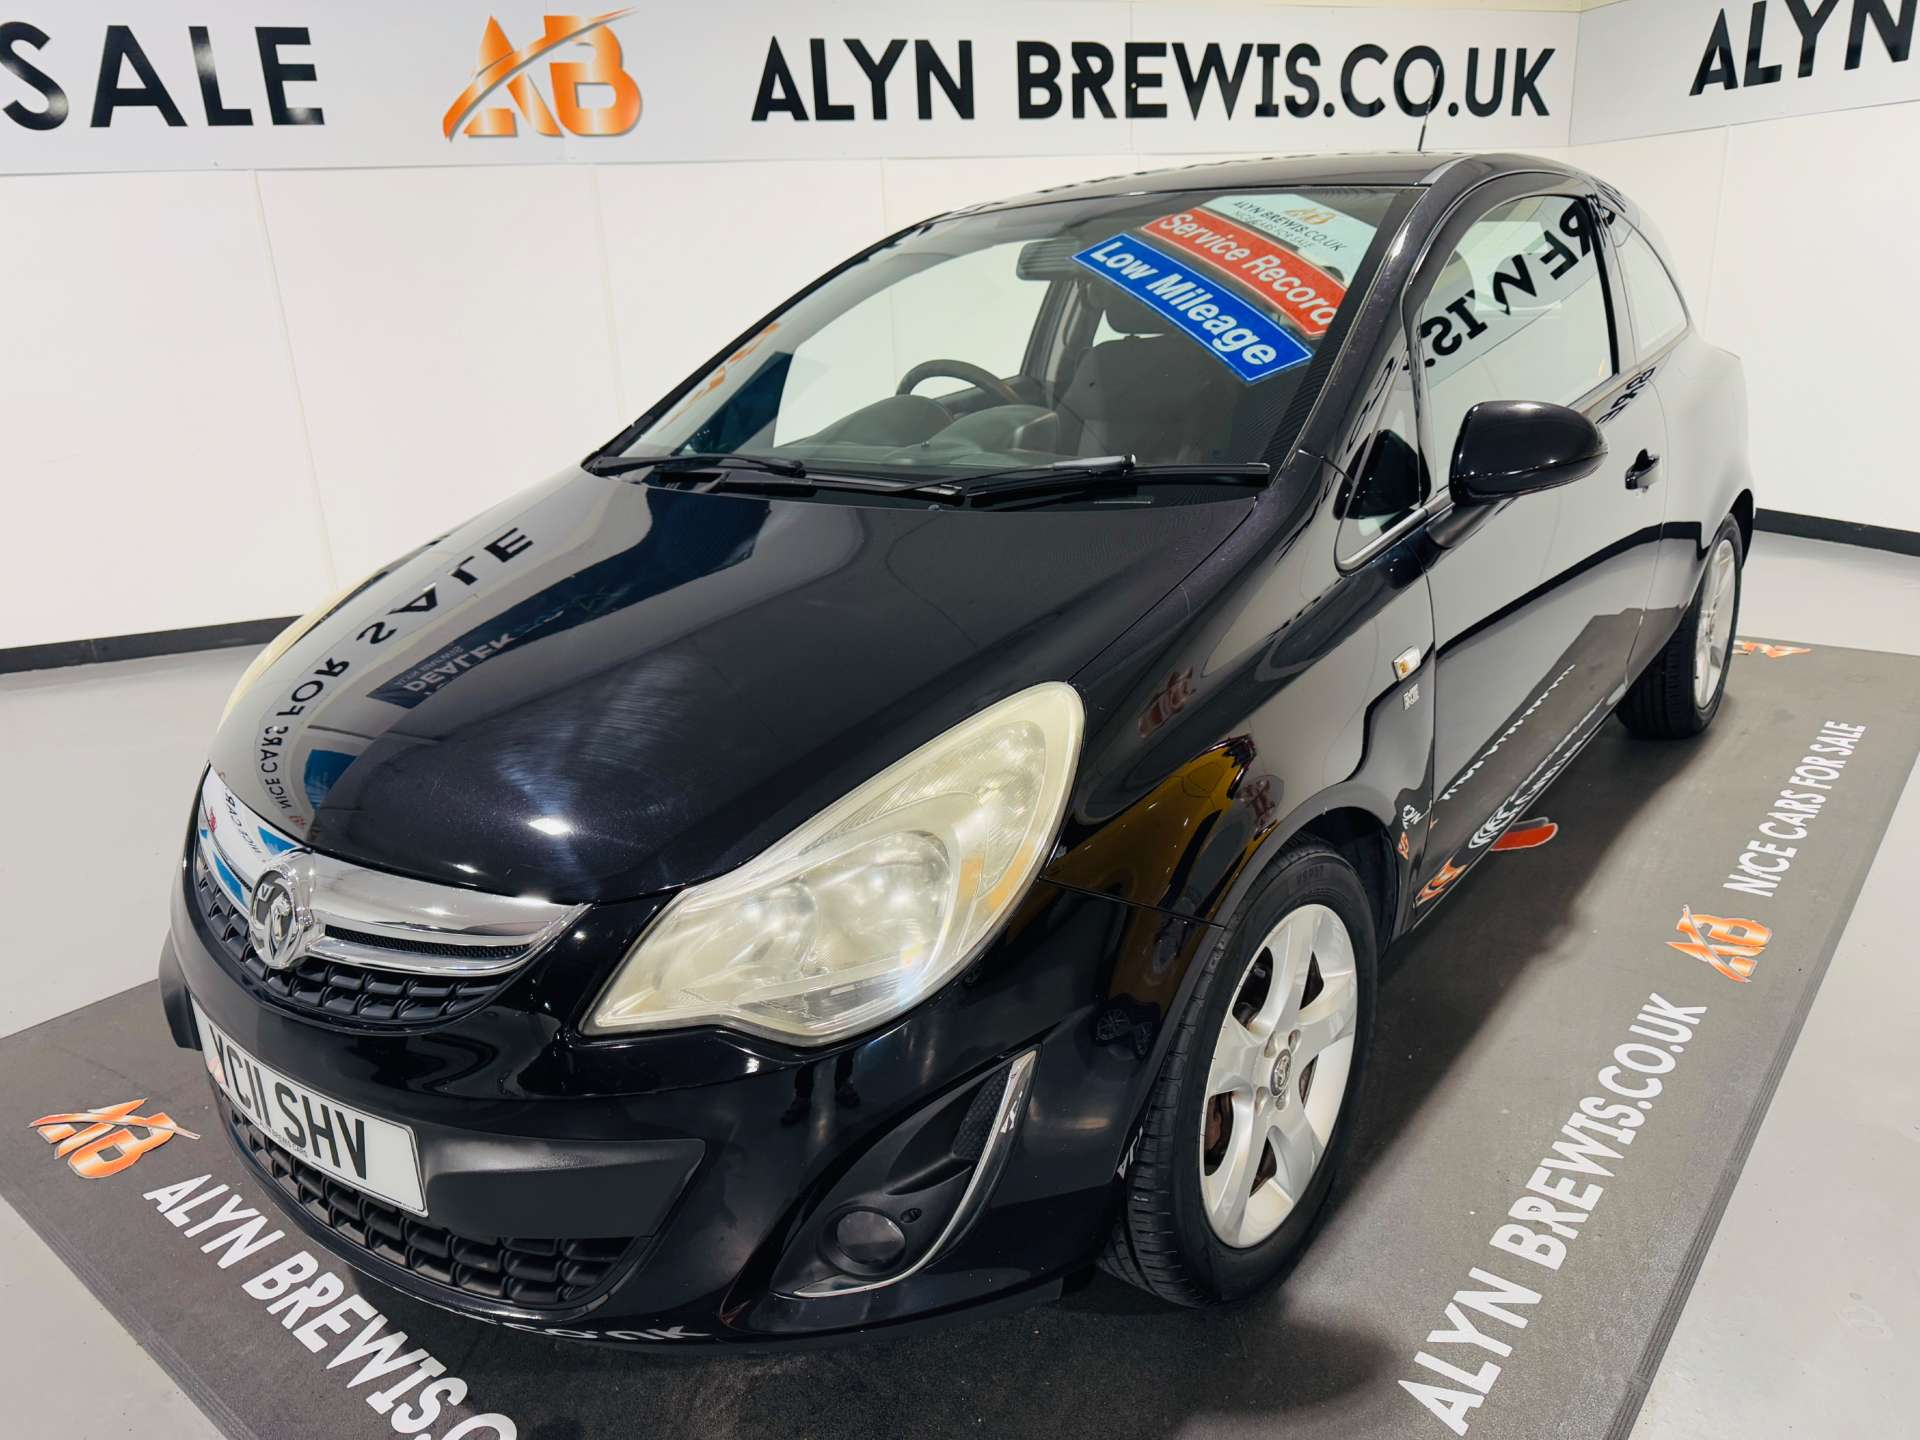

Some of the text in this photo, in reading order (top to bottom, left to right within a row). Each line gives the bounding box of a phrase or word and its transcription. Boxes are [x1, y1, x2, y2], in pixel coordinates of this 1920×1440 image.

[0, 21, 325, 131] SALE
[751, 35, 1556, 121] ALYN BREWIS.CO.UK
[1689, 0, 1918, 96] ALYN
[1160, 213, 1247, 261] Service
[1090, 241, 1278, 365] Low Mileage
[1722, 720, 1866, 897] NICE CARS FOR SALE
[274, 1081, 367, 1180] SHV
[142, 1174, 285, 1269] ALYN
[1398, 992, 1708, 1436] ALYN BREWIS.CO.UK
